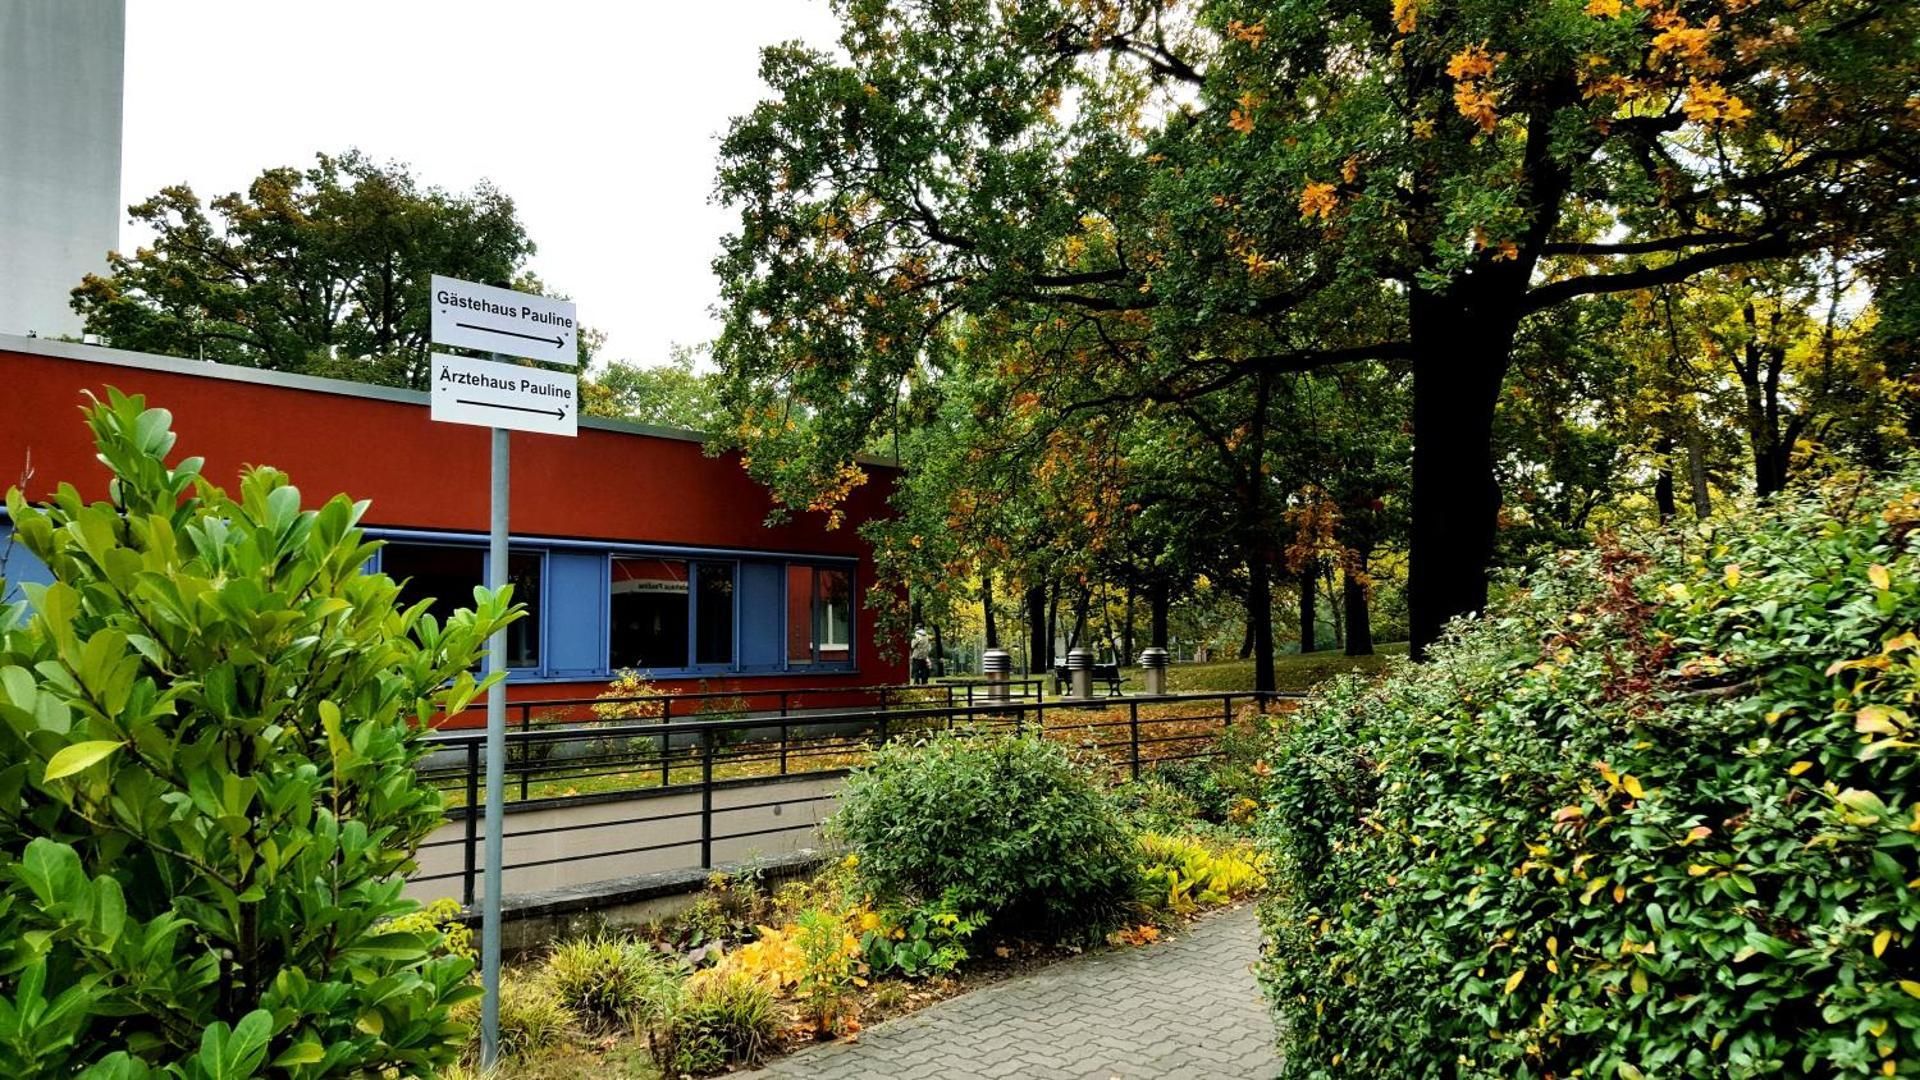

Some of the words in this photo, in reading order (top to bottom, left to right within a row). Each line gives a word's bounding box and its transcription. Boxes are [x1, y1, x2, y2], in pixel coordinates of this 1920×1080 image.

[437, 291, 517, 317] Gästehaus
[522, 307, 573, 328] Pauline
[440, 366, 516, 391] Ärztehaus
[521, 380, 572, 399] Pauline
